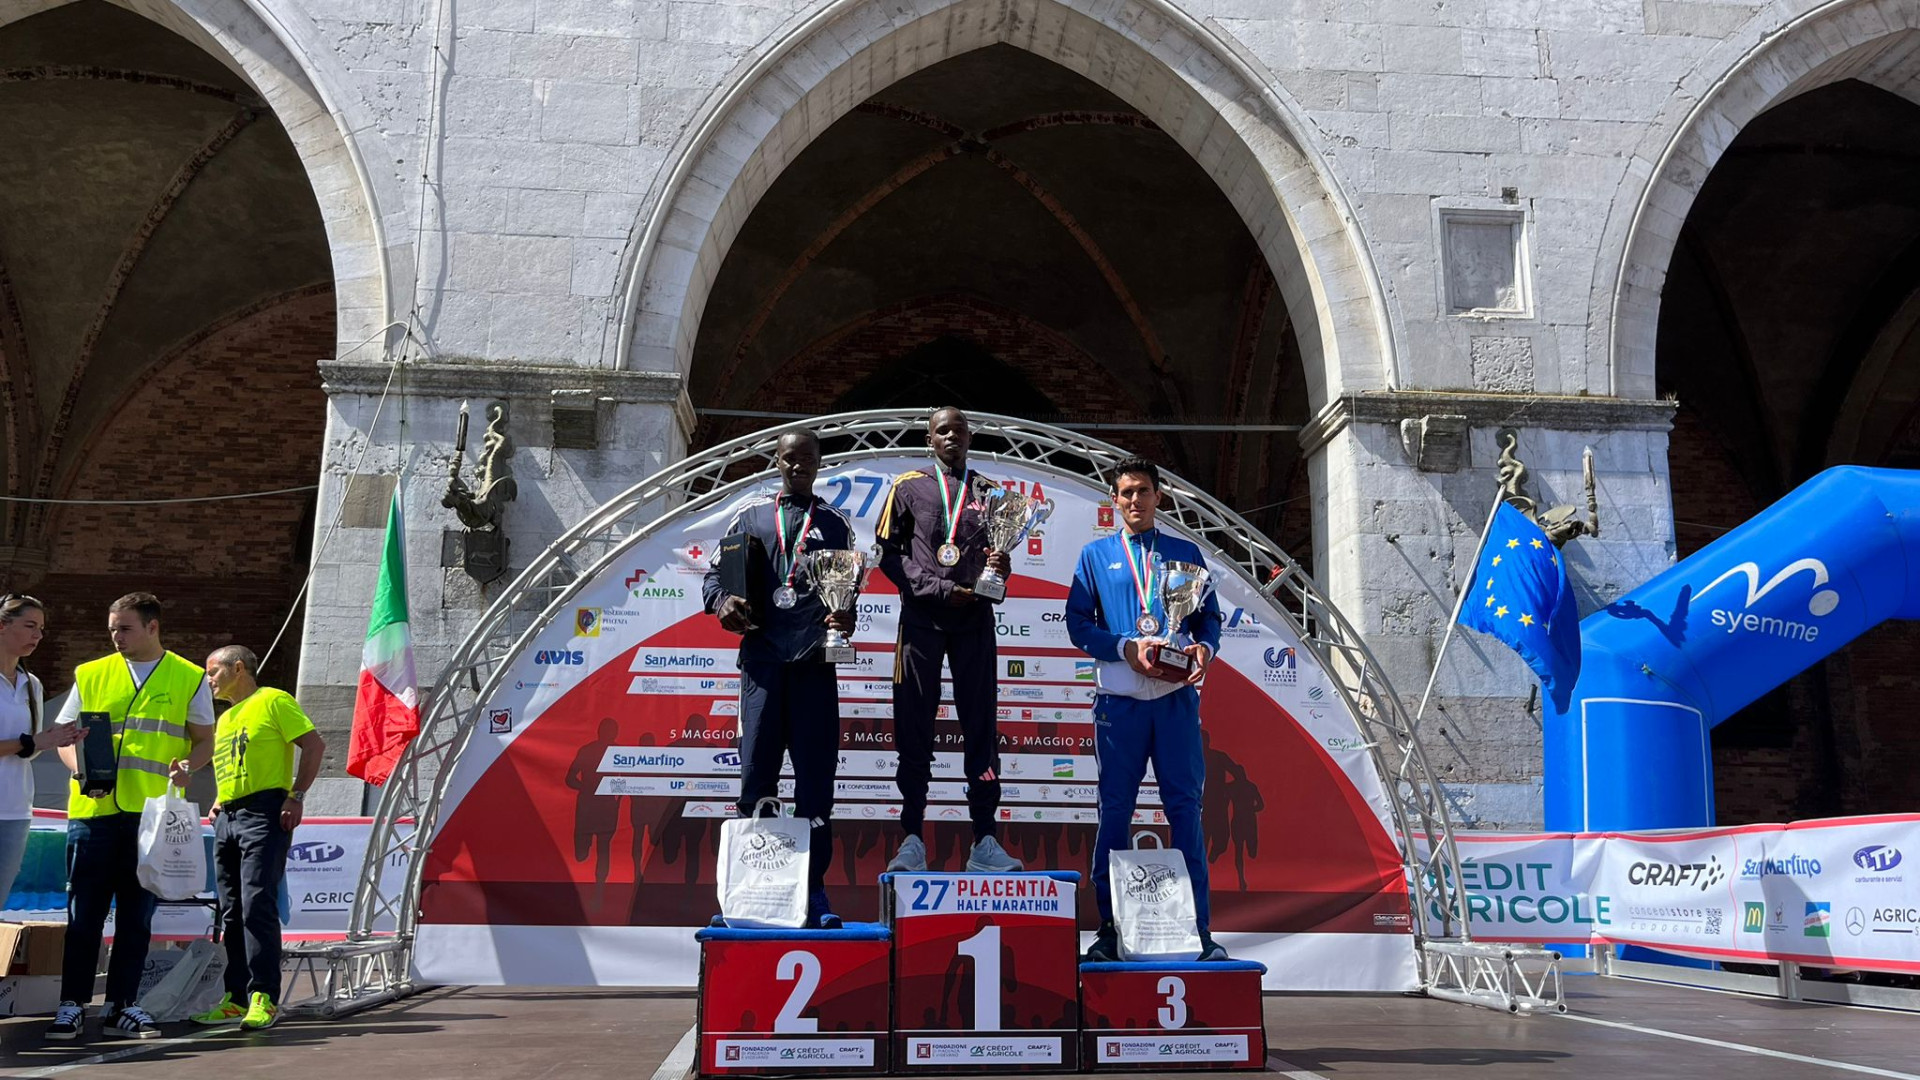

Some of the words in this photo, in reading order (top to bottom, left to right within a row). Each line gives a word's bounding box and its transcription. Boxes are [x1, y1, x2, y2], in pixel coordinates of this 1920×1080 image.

[827, 475, 883, 517] 27
[642, 588, 684, 598] ANPAS
[1711, 610, 1819, 642] syemme
[534, 650, 584, 665] AVIS
[701, 680, 714, 688] UP
[670, 730, 676, 738] 5
[682, 729, 734, 739] MAGGIO
[844, 732, 850, 742] 5
[854, 732, 893, 742] MAGG
[1012, 736, 1018, 745] 5
[1024, 736, 1074, 746] MAGGIO
[670, 781, 684, 789] UP
[1628, 862, 1706, 886] CRAFT
[912, 880, 950, 911] 27
[958, 880, 1058, 897] PLACENTIA
[302, 892, 354, 903] AGRIC
[958, 900, 988, 911] HALF
[992, 900, 1058, 912] MARATHON
[1873, 908, 1920, 922] AGRIC
[958, 926, 1000, 1031] 1
[774, 950, 822, 1034] 2
[1156, 976, 1188, 1030] 3
